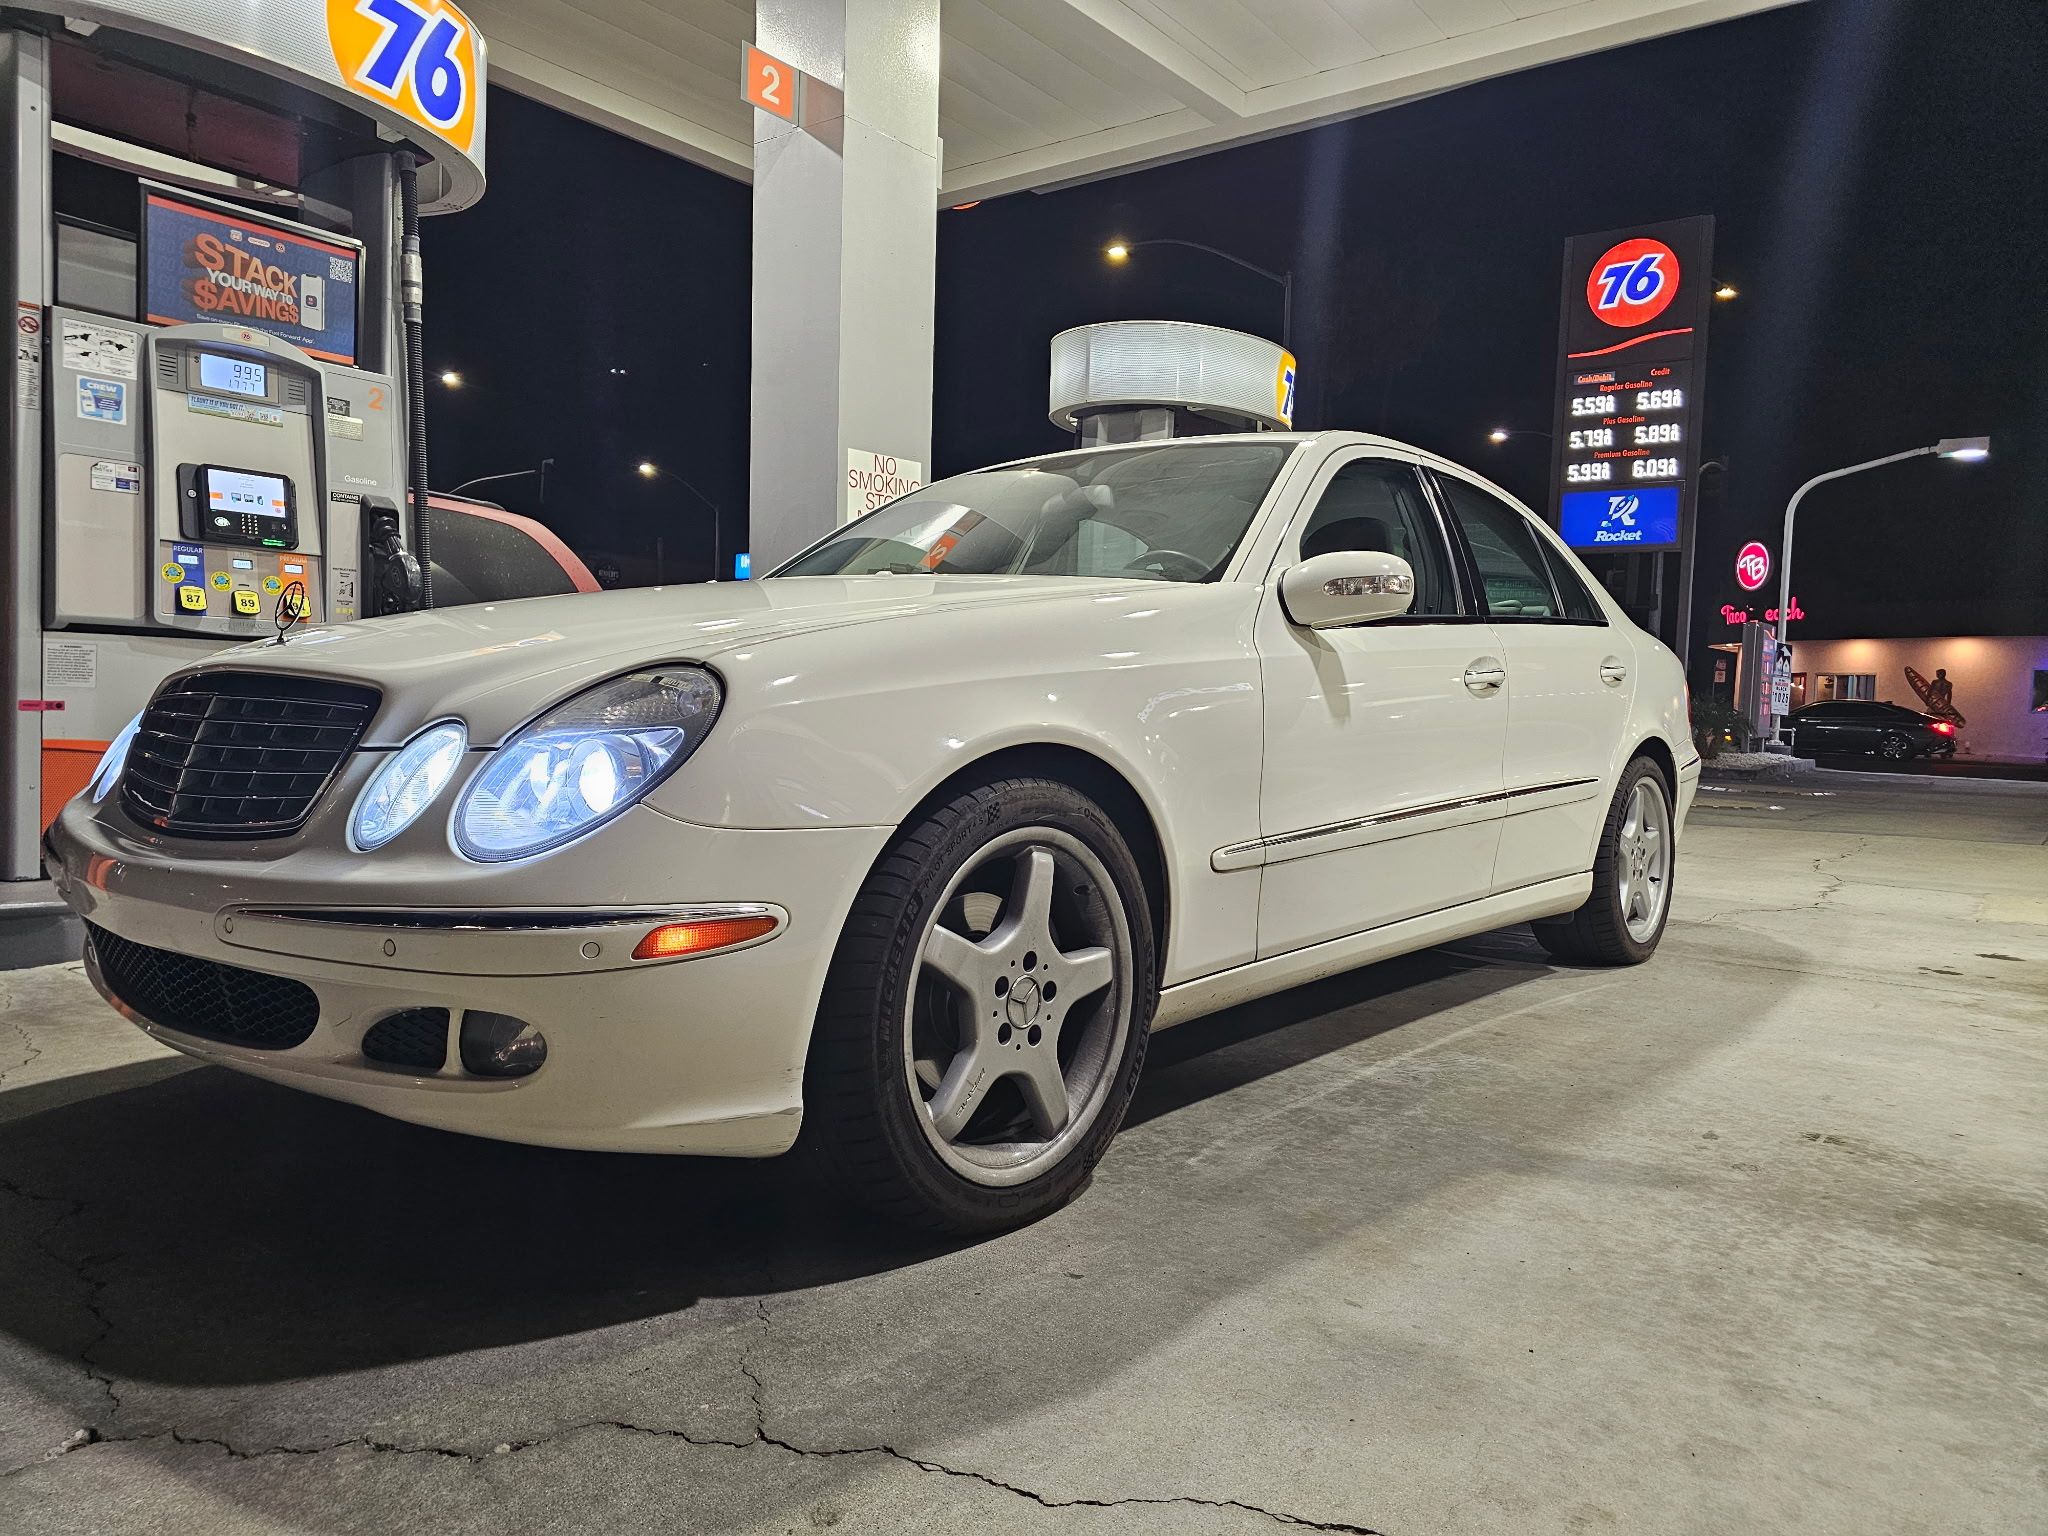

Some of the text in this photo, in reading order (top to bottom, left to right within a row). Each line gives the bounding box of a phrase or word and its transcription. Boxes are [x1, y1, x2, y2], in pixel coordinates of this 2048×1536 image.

[354, 0, 466, 129] 76
[761, 64, 781, 105] 2
[195, 232, 298, 298] STACK
[206, 267, 252, 294] YOUR
[253, 283, 279, 301] WAY
[280, 292, 294, 305] TO
[1598, 253, 1665, 309] 76
[280, 331, 301, 341] Forward
[194, 354, 200, 364] $
[1650, 368, 1672, 376] Credit
[86, 382, 117, 393] CREW
[1282, 366, 1295, 416] 7
[1600, 381, 1653, 393] Regular Gasoline
[367, 386, 385, 412] 2
[1603, 416, 1645, 425] Plus Gasoline
[1594, 449, 1650, 459] Premium Gasoline
[874, 454, 897, 476] NO
[344, 475, 378, 486] Gasoline
[332, 492, 359, 501] CONTAINS
[1594, 530, 1643, 542] Rocket
[173, 545, 204, 554] REGULAR
[1740, 555, 1766, 580] TB
[186, 594, 200, 604] 87
[240, 598, 255, 608] 89
[1720, 604, 1747, 625] Taco
[924, 855, 945, 889] PILOT
[945, 825, 973, 856] SPORT
